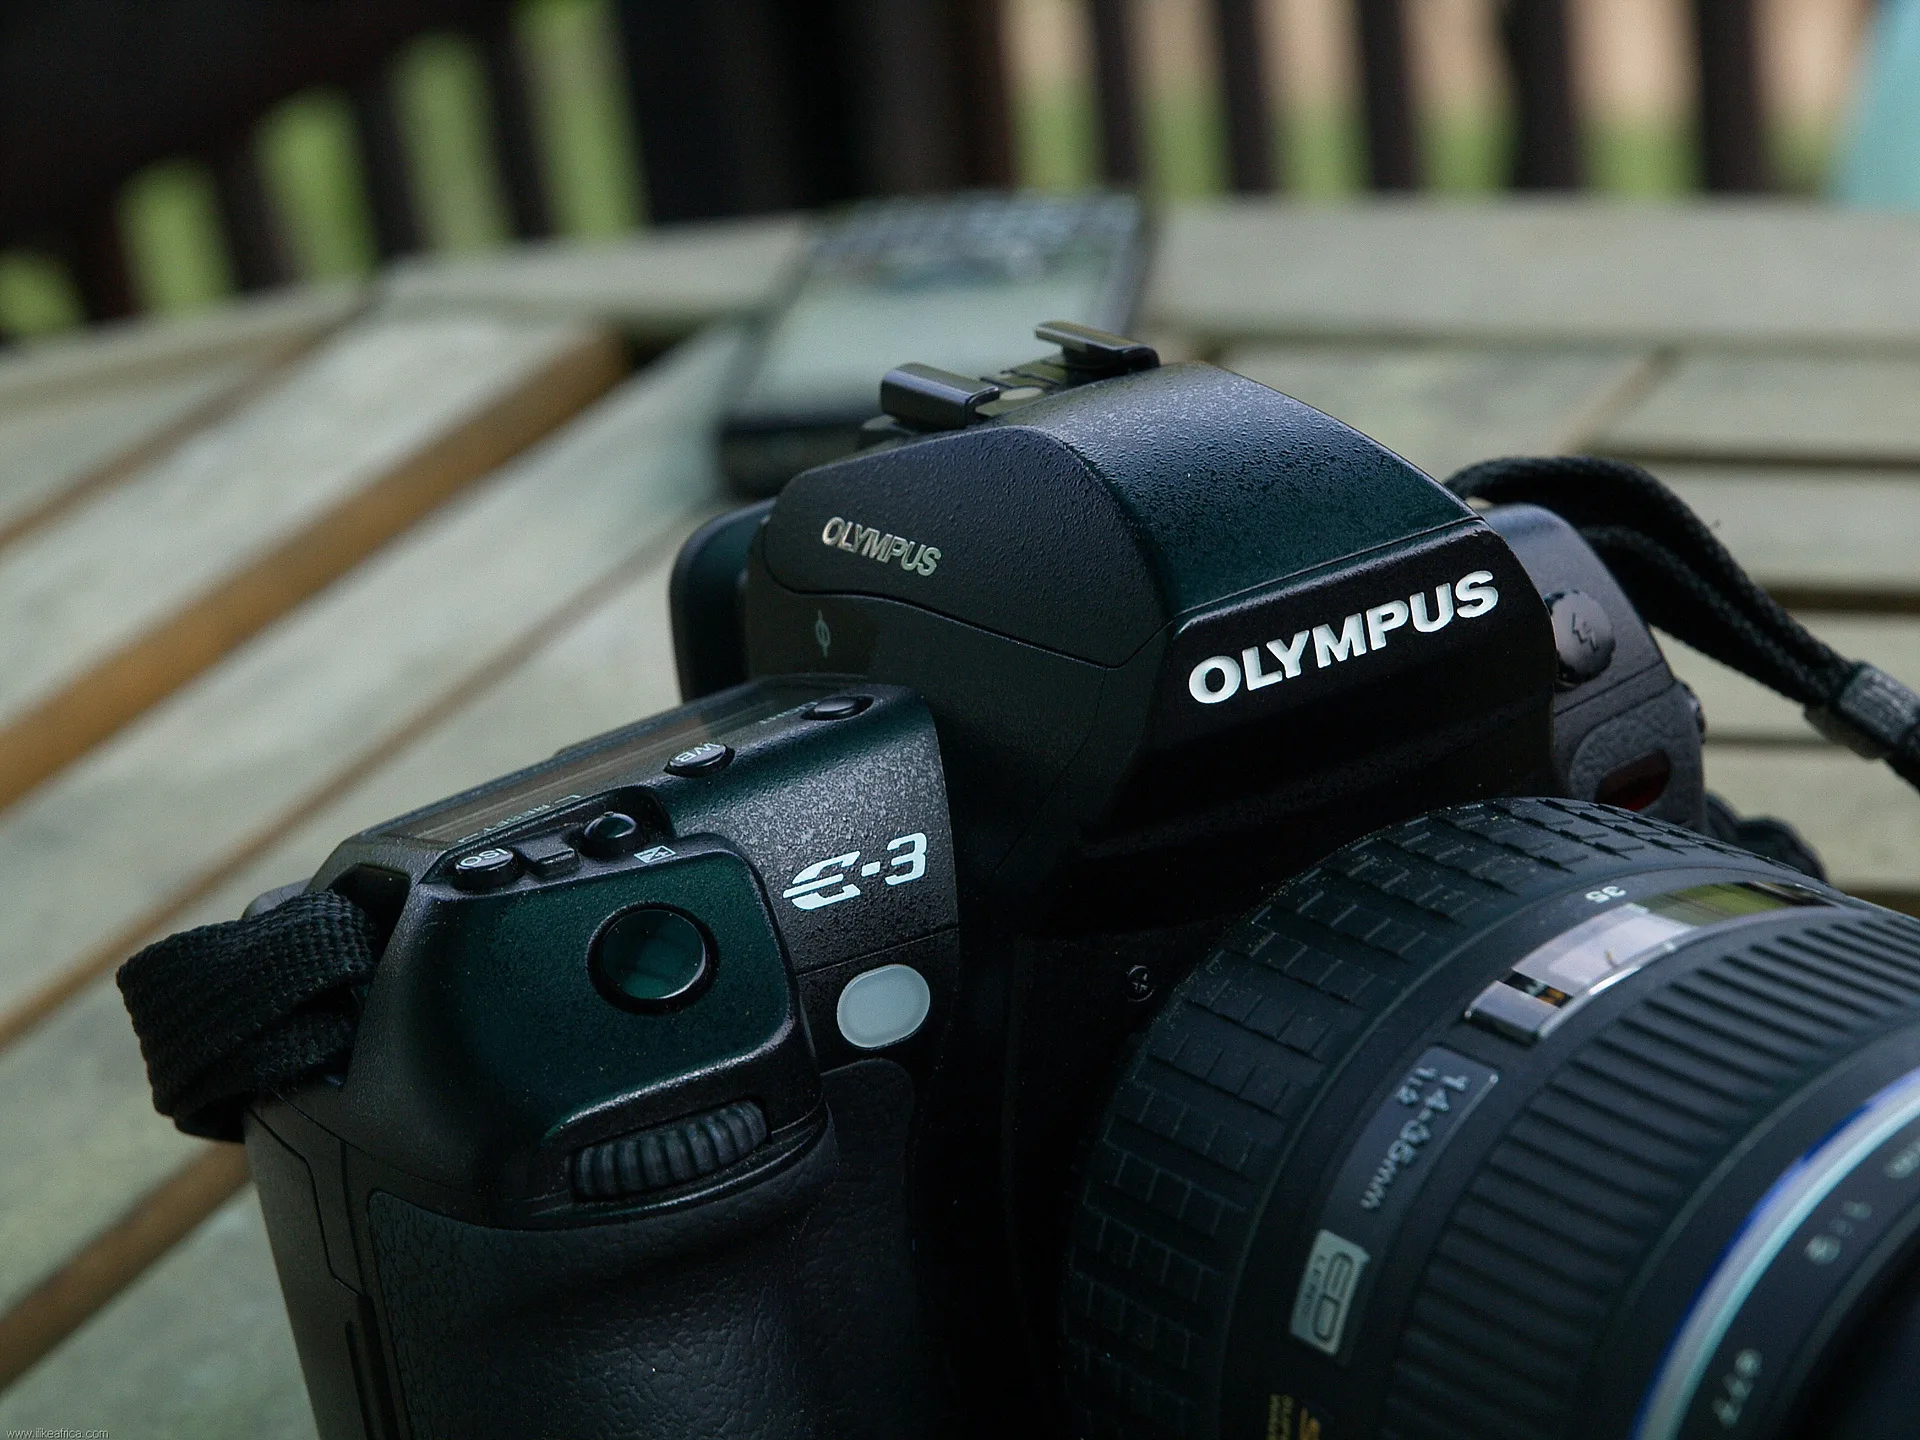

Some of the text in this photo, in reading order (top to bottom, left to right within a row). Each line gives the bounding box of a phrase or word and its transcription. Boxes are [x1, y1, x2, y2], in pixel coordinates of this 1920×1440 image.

[822, 516, 942, 576] OLYMPUS
[1189, 570, 1498, 704] OLYMPUS
[675, 742, 720, 762] WB
[460, 848, 508, 867] ISO
[1585, 885, 1627, 904] 35
